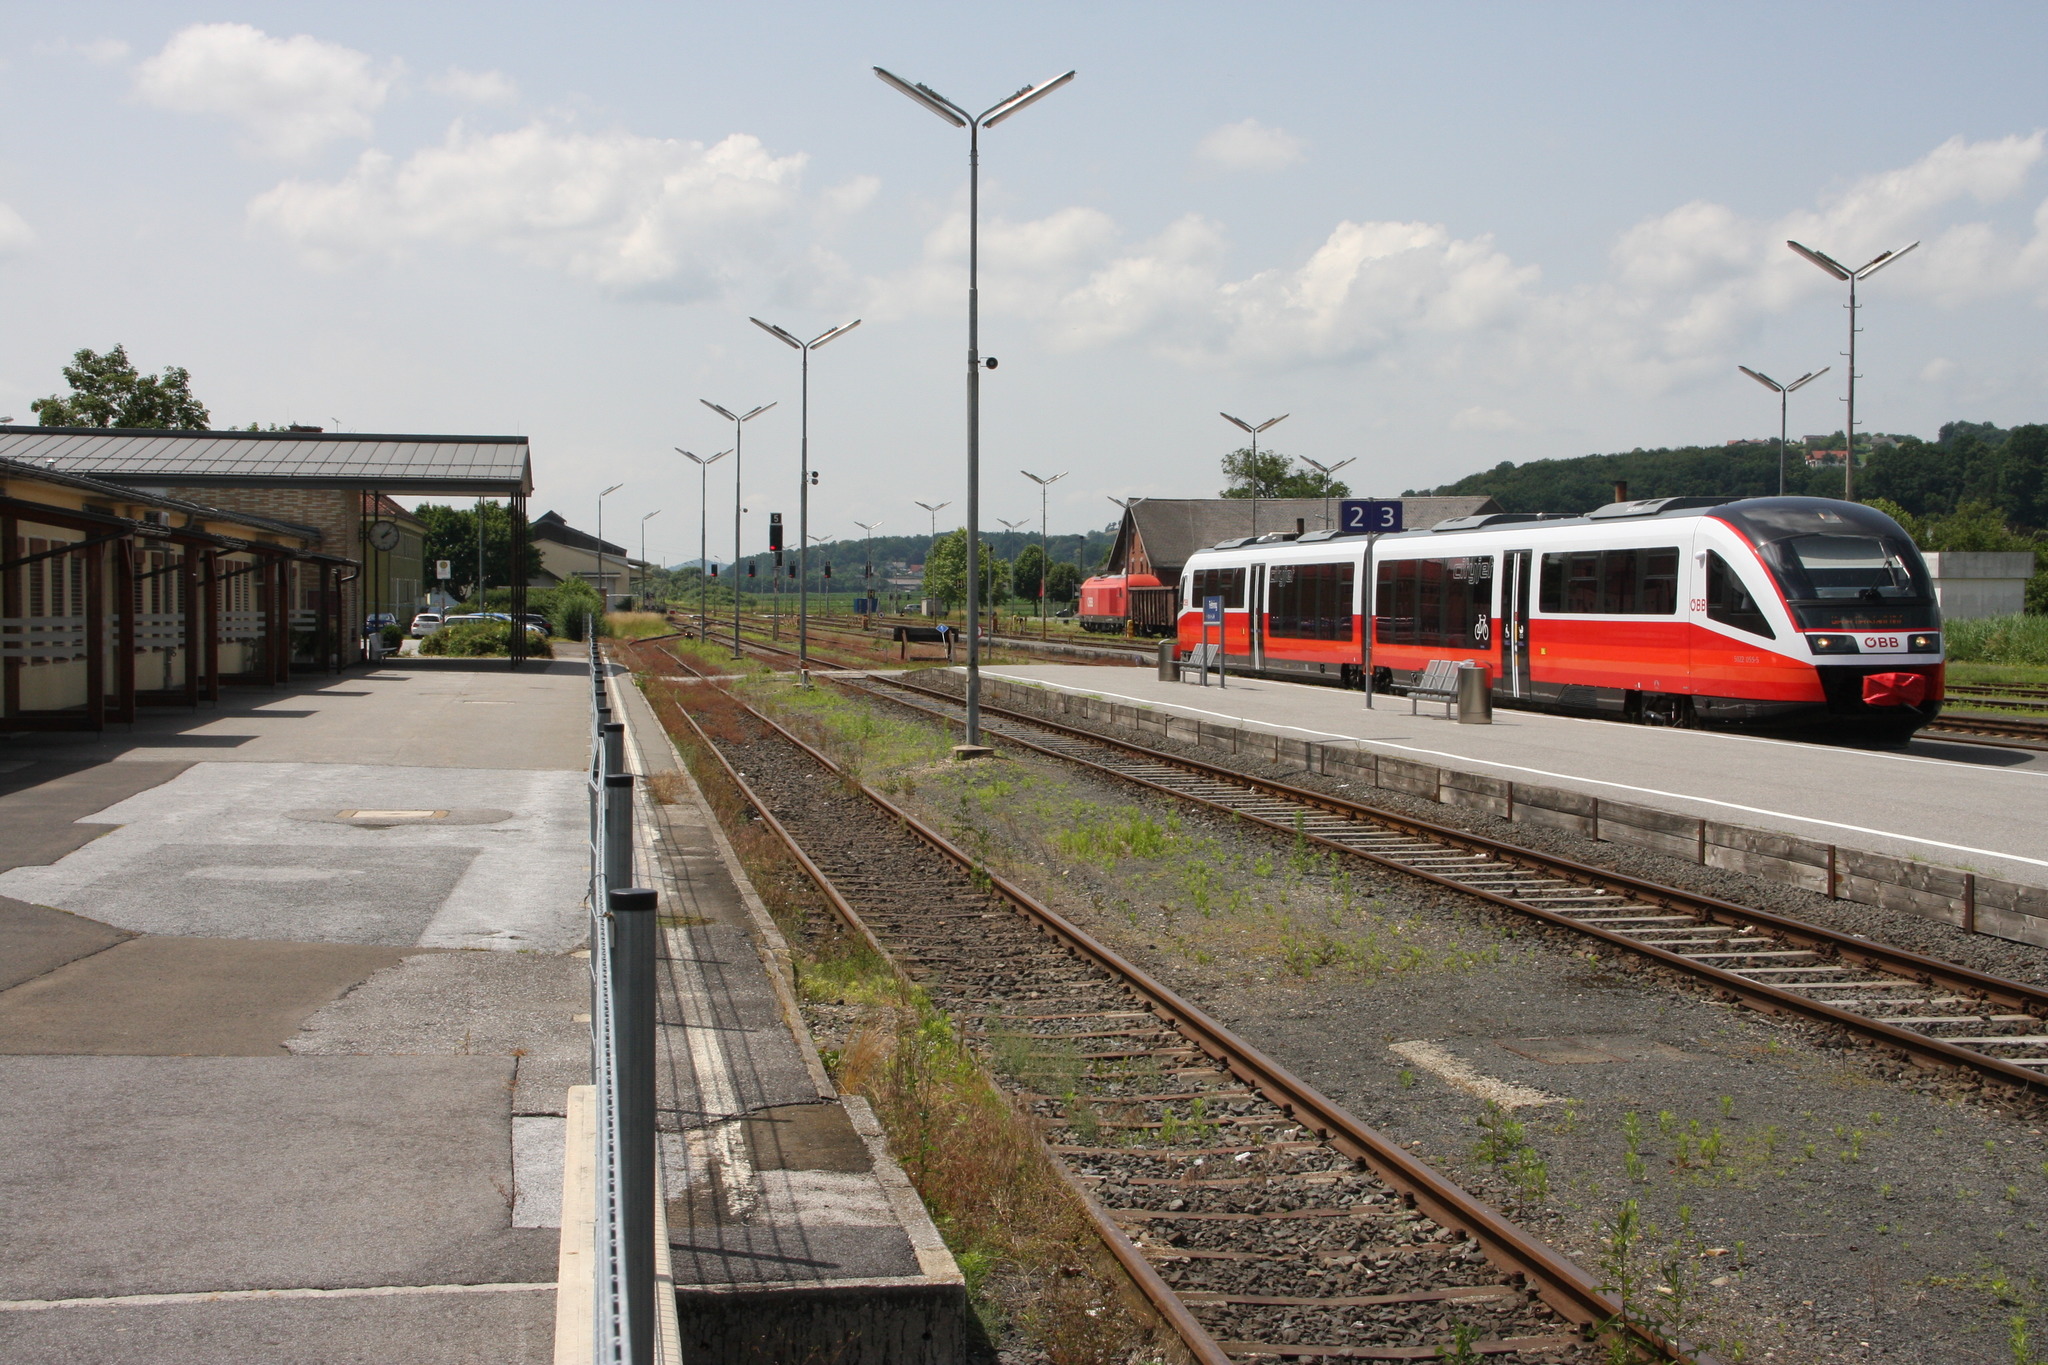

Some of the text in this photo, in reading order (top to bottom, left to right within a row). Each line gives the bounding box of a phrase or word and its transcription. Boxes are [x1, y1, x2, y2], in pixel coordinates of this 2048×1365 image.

[773, 514, 779, 523] 5
[1350, 506, 1395, 527] 2 3
[1453, 556, 1494, 585] cityjet
[1690, 598, 1706, 612] ÖBB
[1864, 636, 1900, 649] ÖBB
